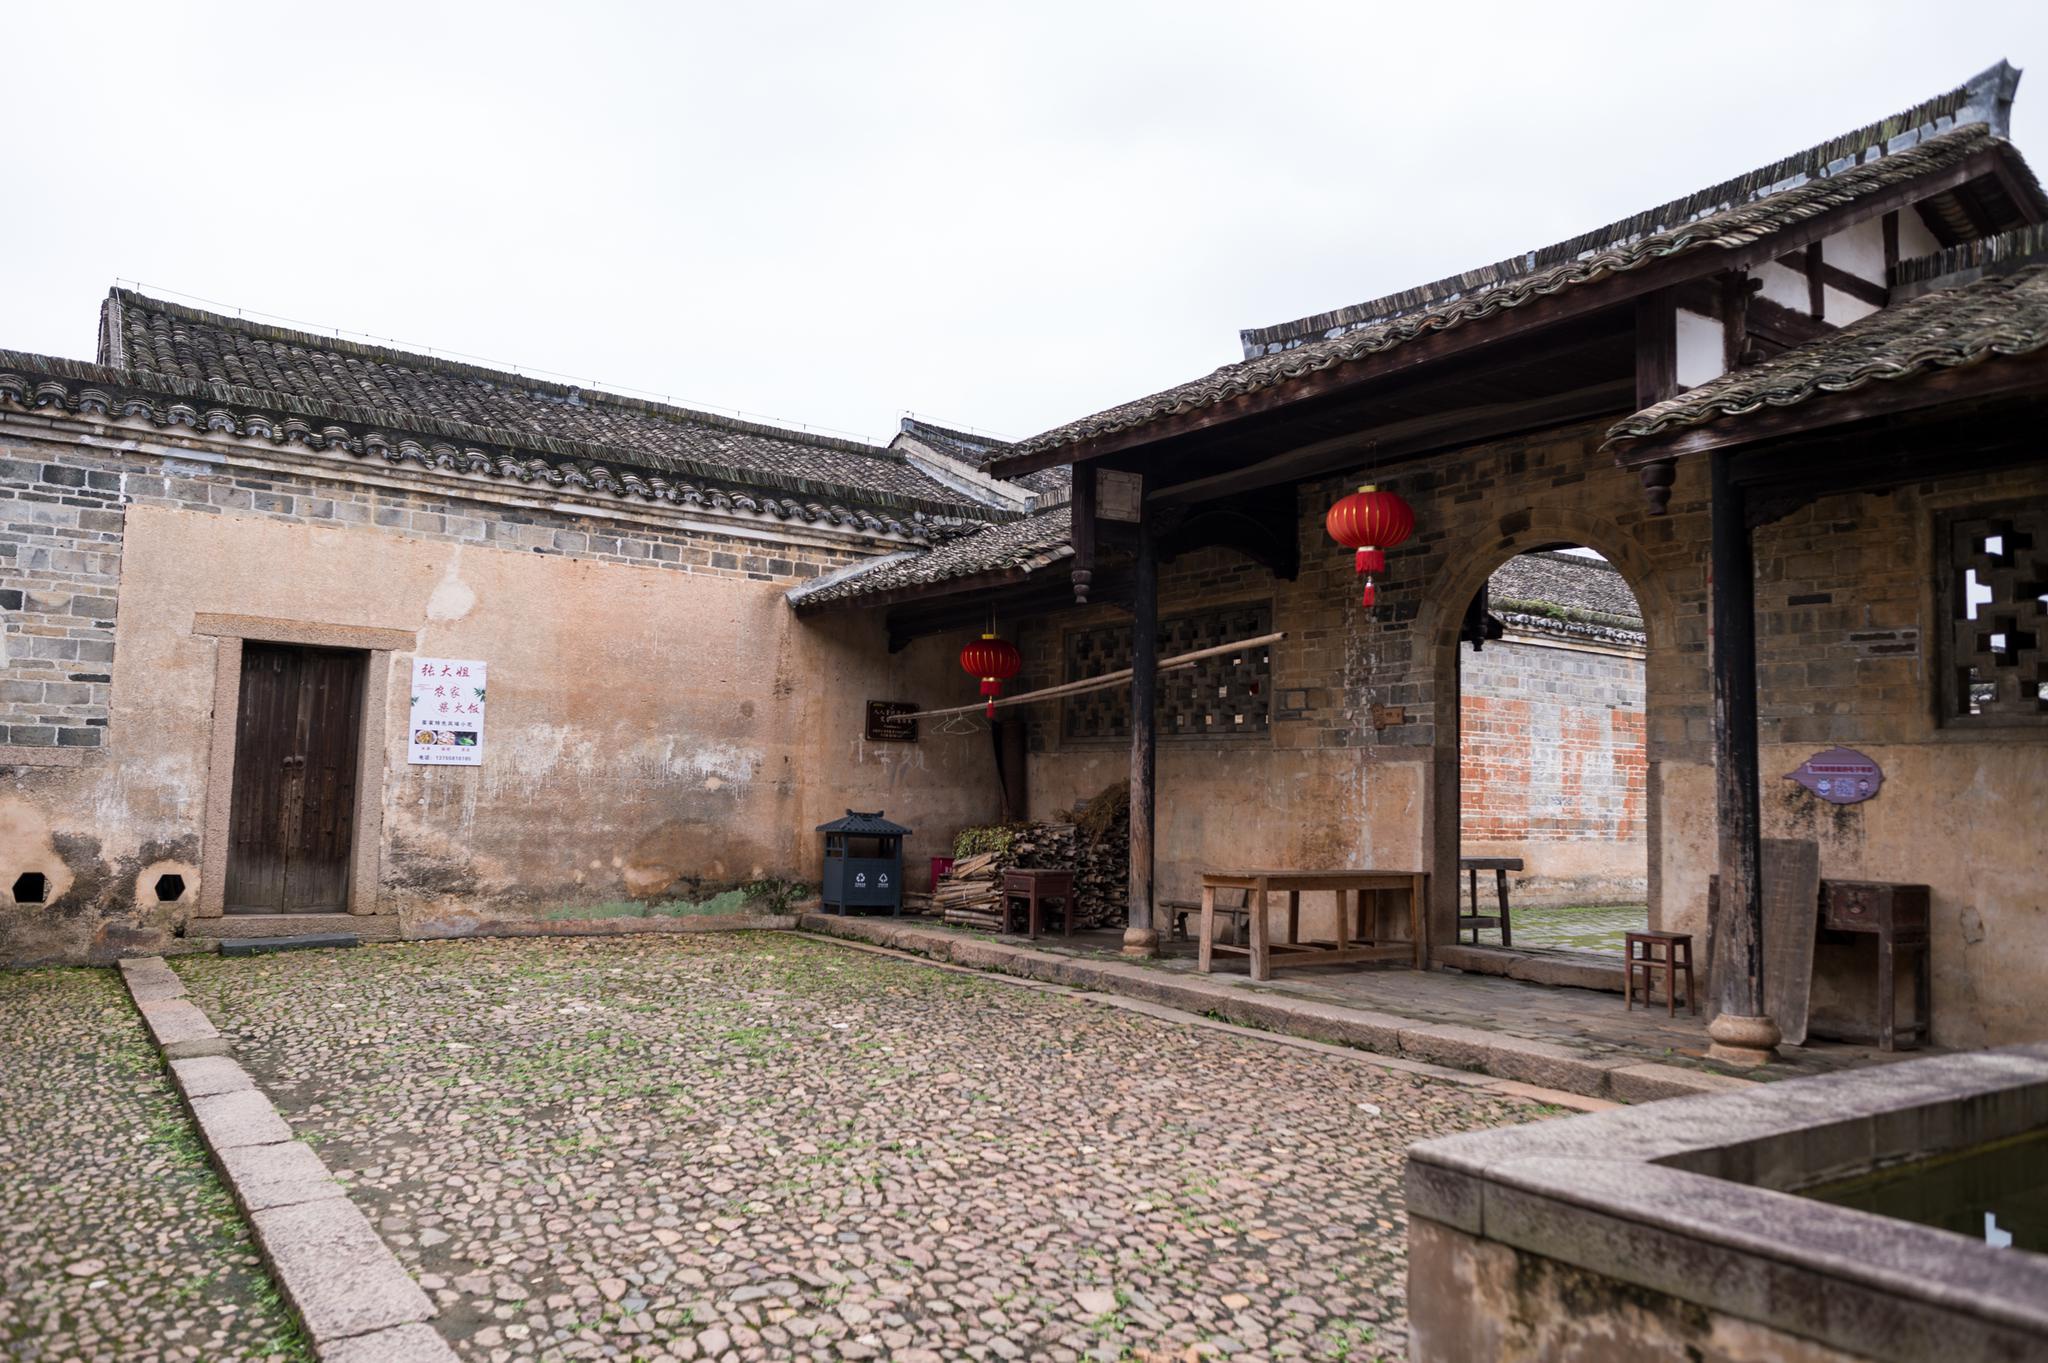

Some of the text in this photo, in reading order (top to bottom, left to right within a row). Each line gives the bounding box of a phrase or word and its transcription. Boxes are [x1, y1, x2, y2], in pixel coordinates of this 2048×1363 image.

[421, 664, 470, 677] 张大姐
[434, 685, 460, 699] 农家
